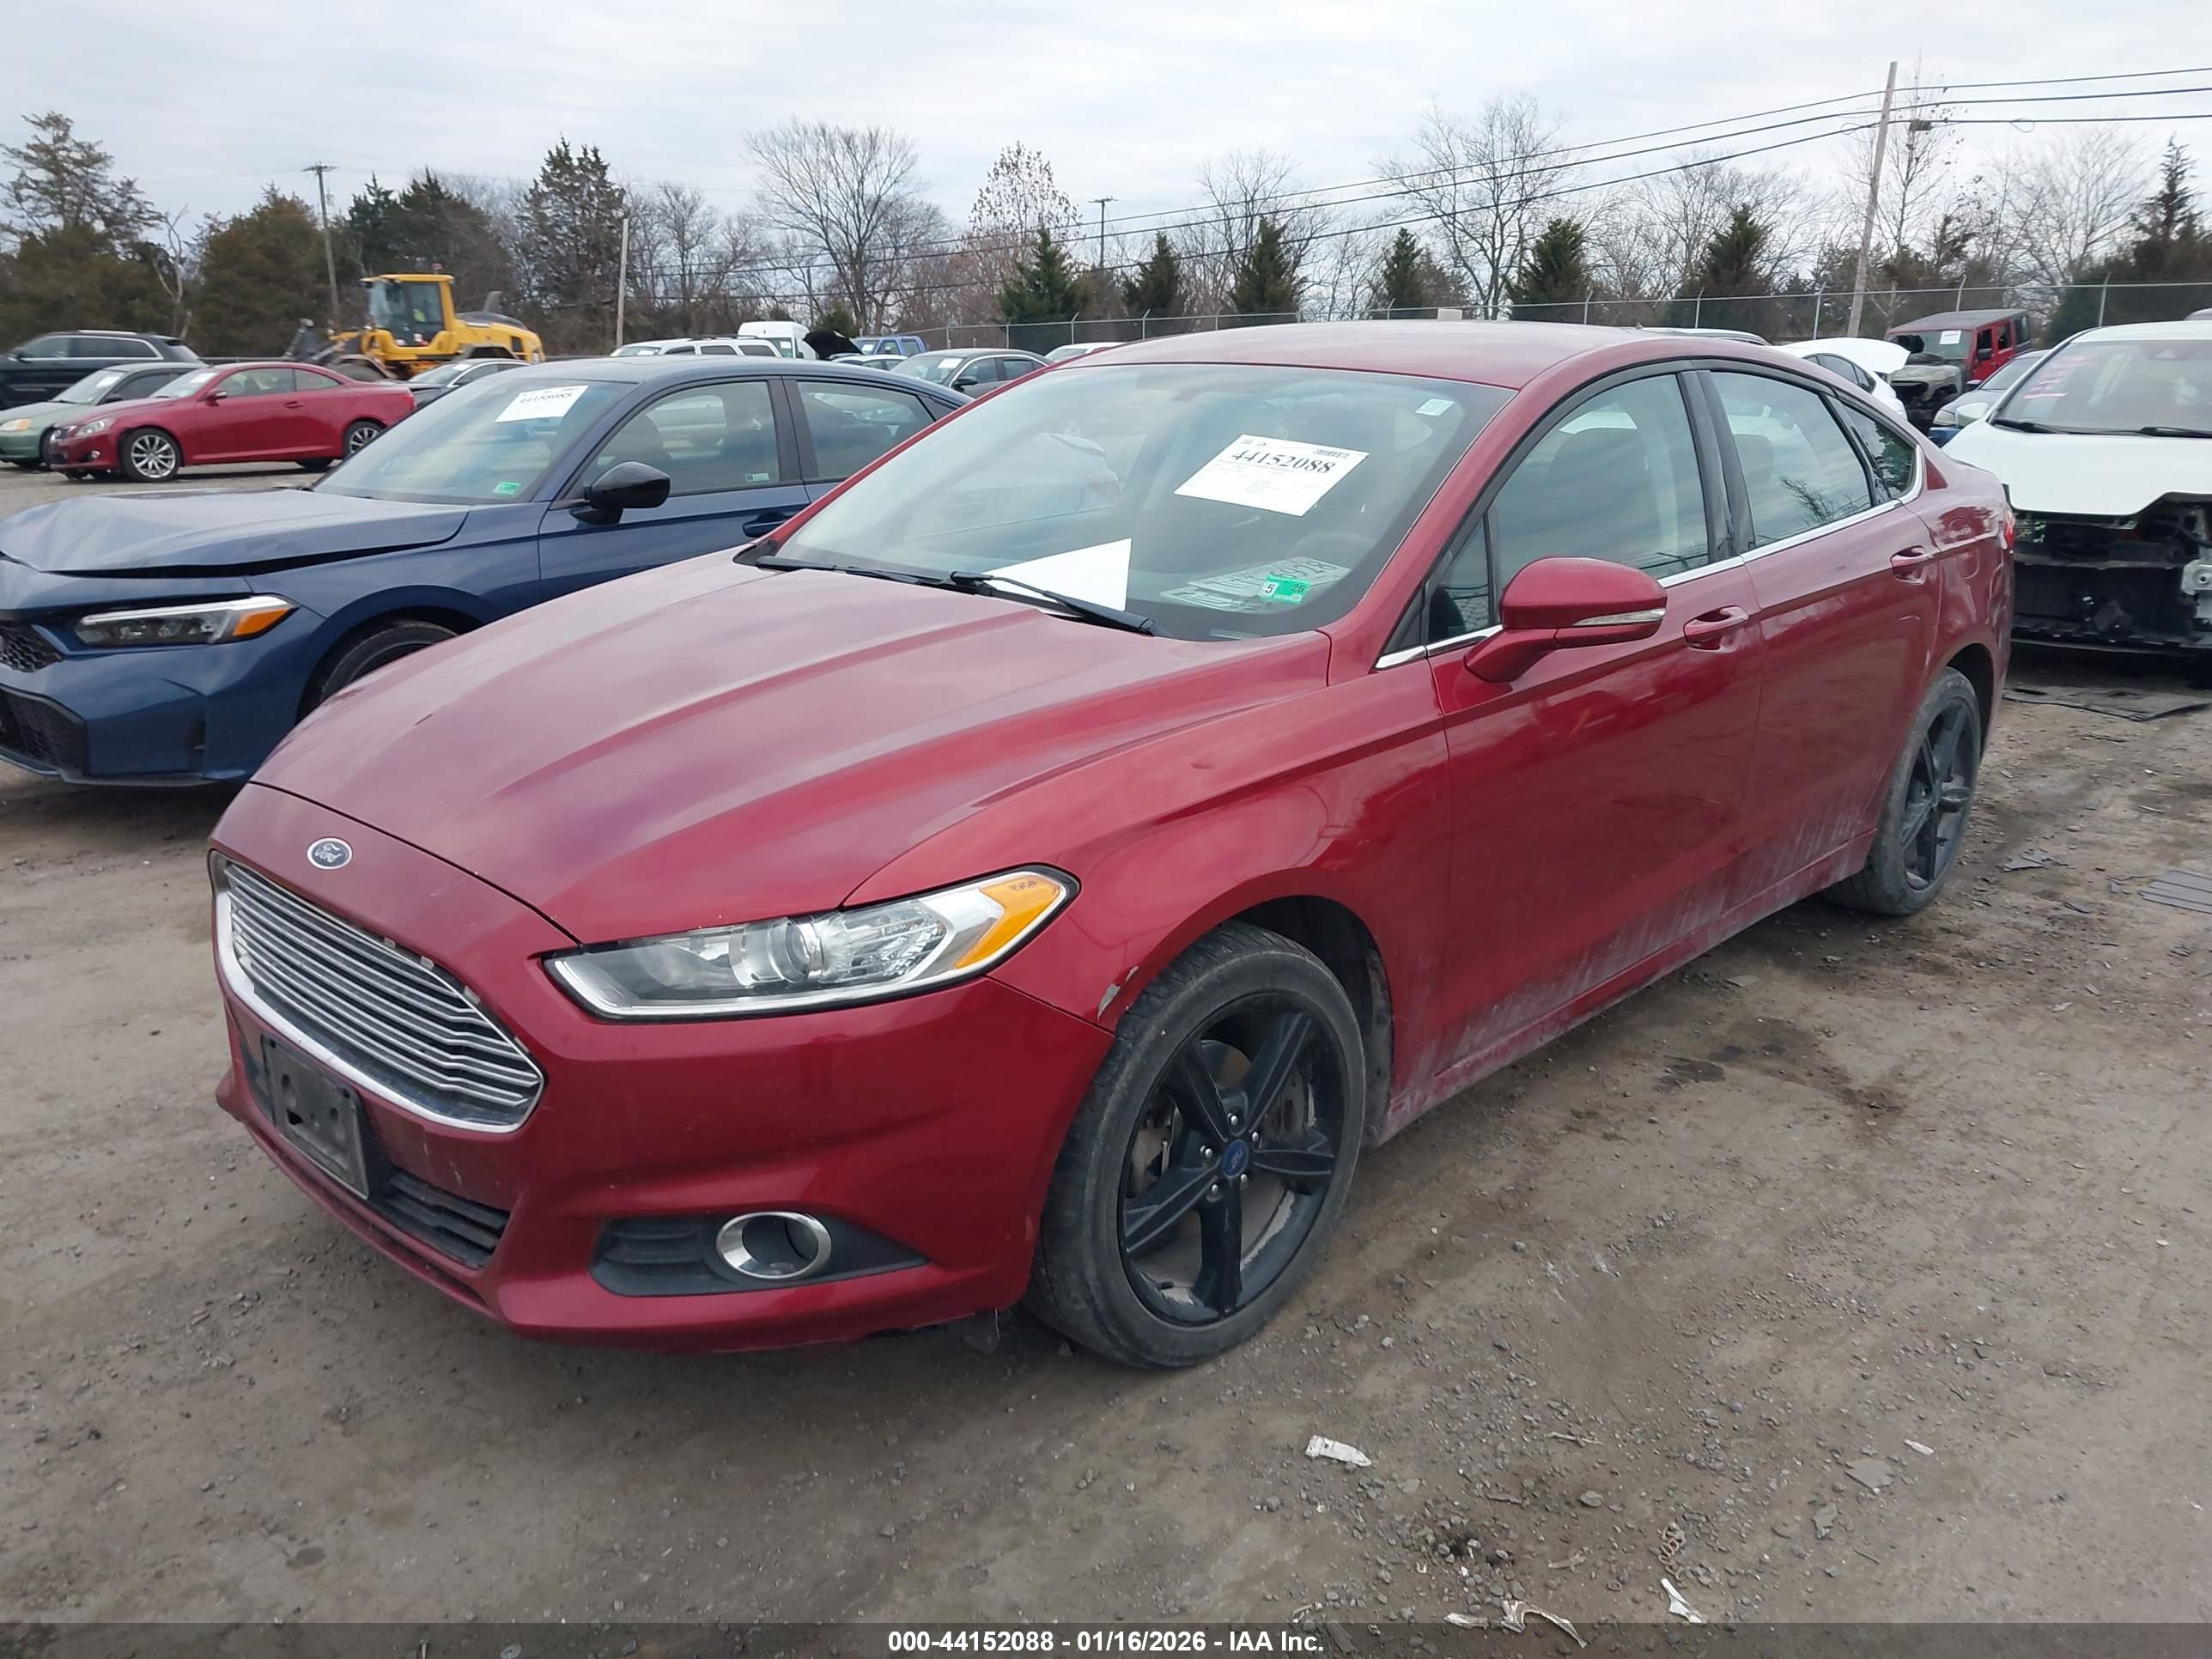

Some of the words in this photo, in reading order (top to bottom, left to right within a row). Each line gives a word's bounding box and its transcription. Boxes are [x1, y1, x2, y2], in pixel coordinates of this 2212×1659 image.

[1231, 450, 1336, 474] 44152088
[1265, 584, 1275, 593] 5
[1291, 583, 1304, 592] 26
